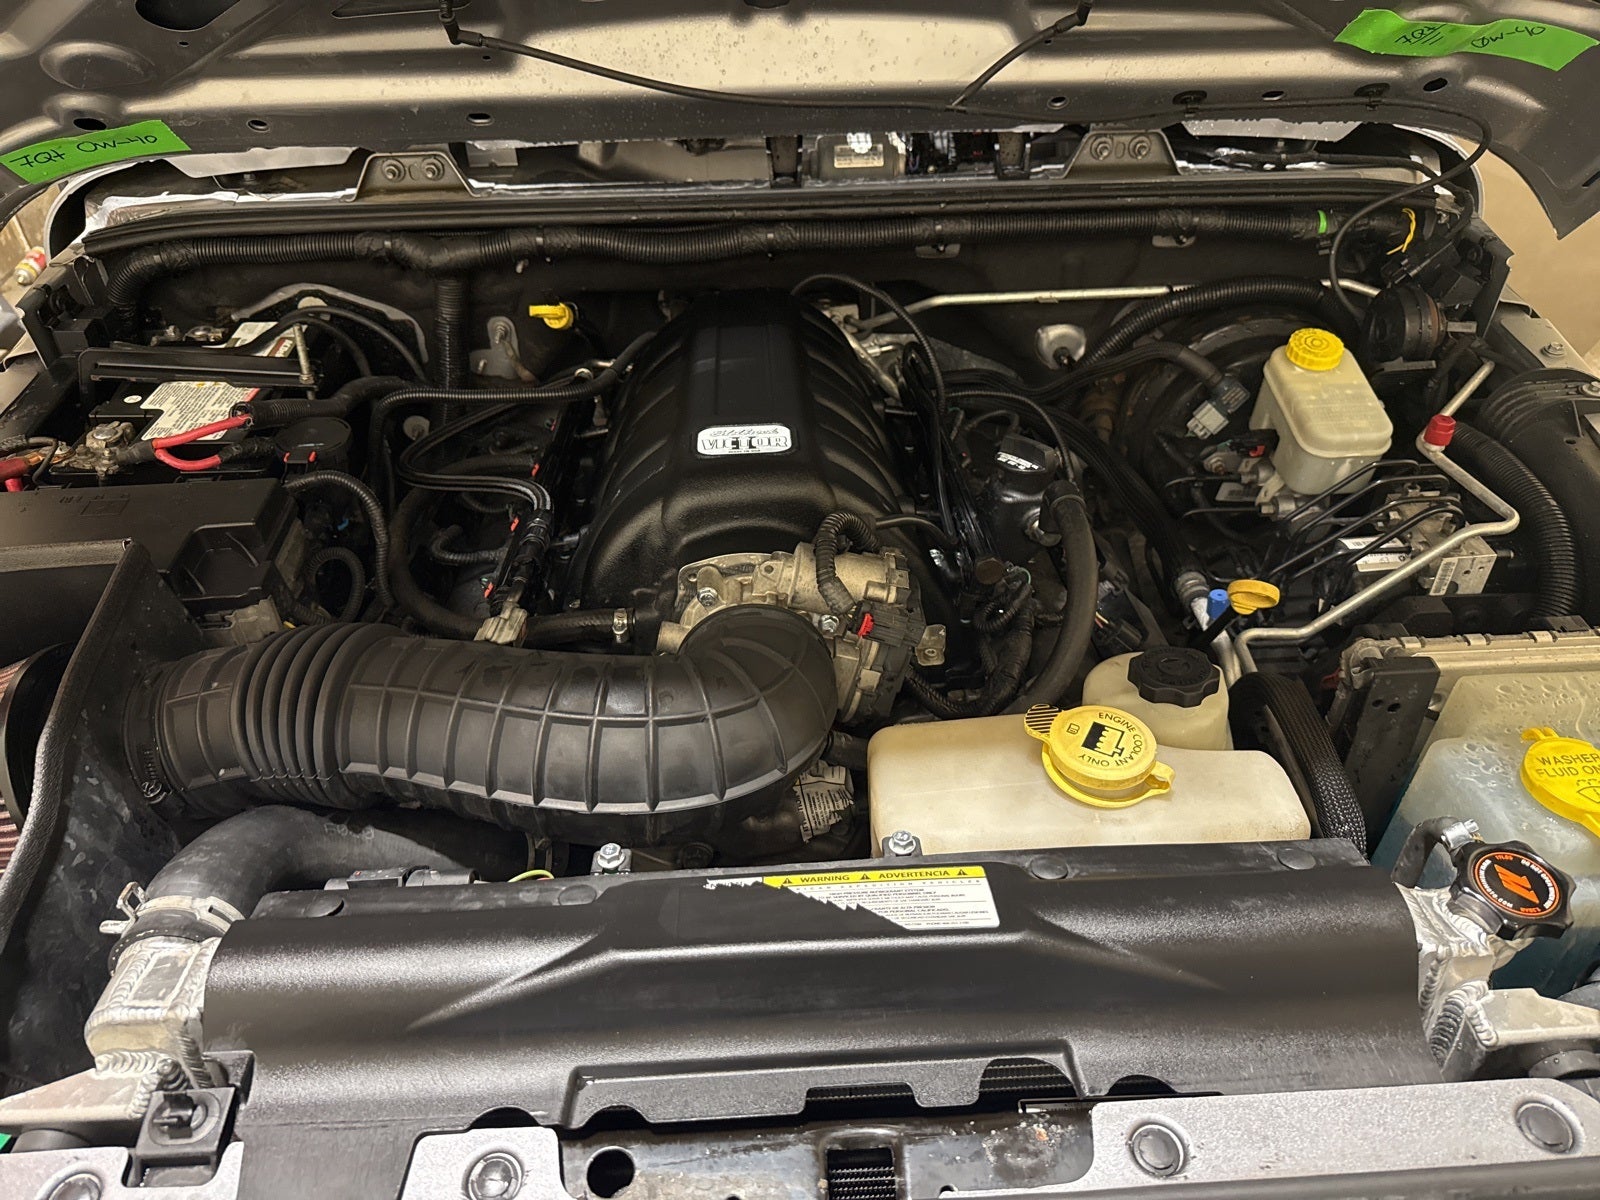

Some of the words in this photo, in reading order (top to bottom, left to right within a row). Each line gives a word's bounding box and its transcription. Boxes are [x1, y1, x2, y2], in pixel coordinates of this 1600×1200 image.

[1098, 712, 1137, 733] ENGINE
[1114, 734, 1143, 767] COOLANT
[1078, 753, 1110, 767] ONLY
[1535, 766, 1579, 778] FLUID
[1581, 764, 1600, 775] ON
[800, 874, 850, 883] WARNING
[879, 870, 950, 879] ADVERTENCIA
